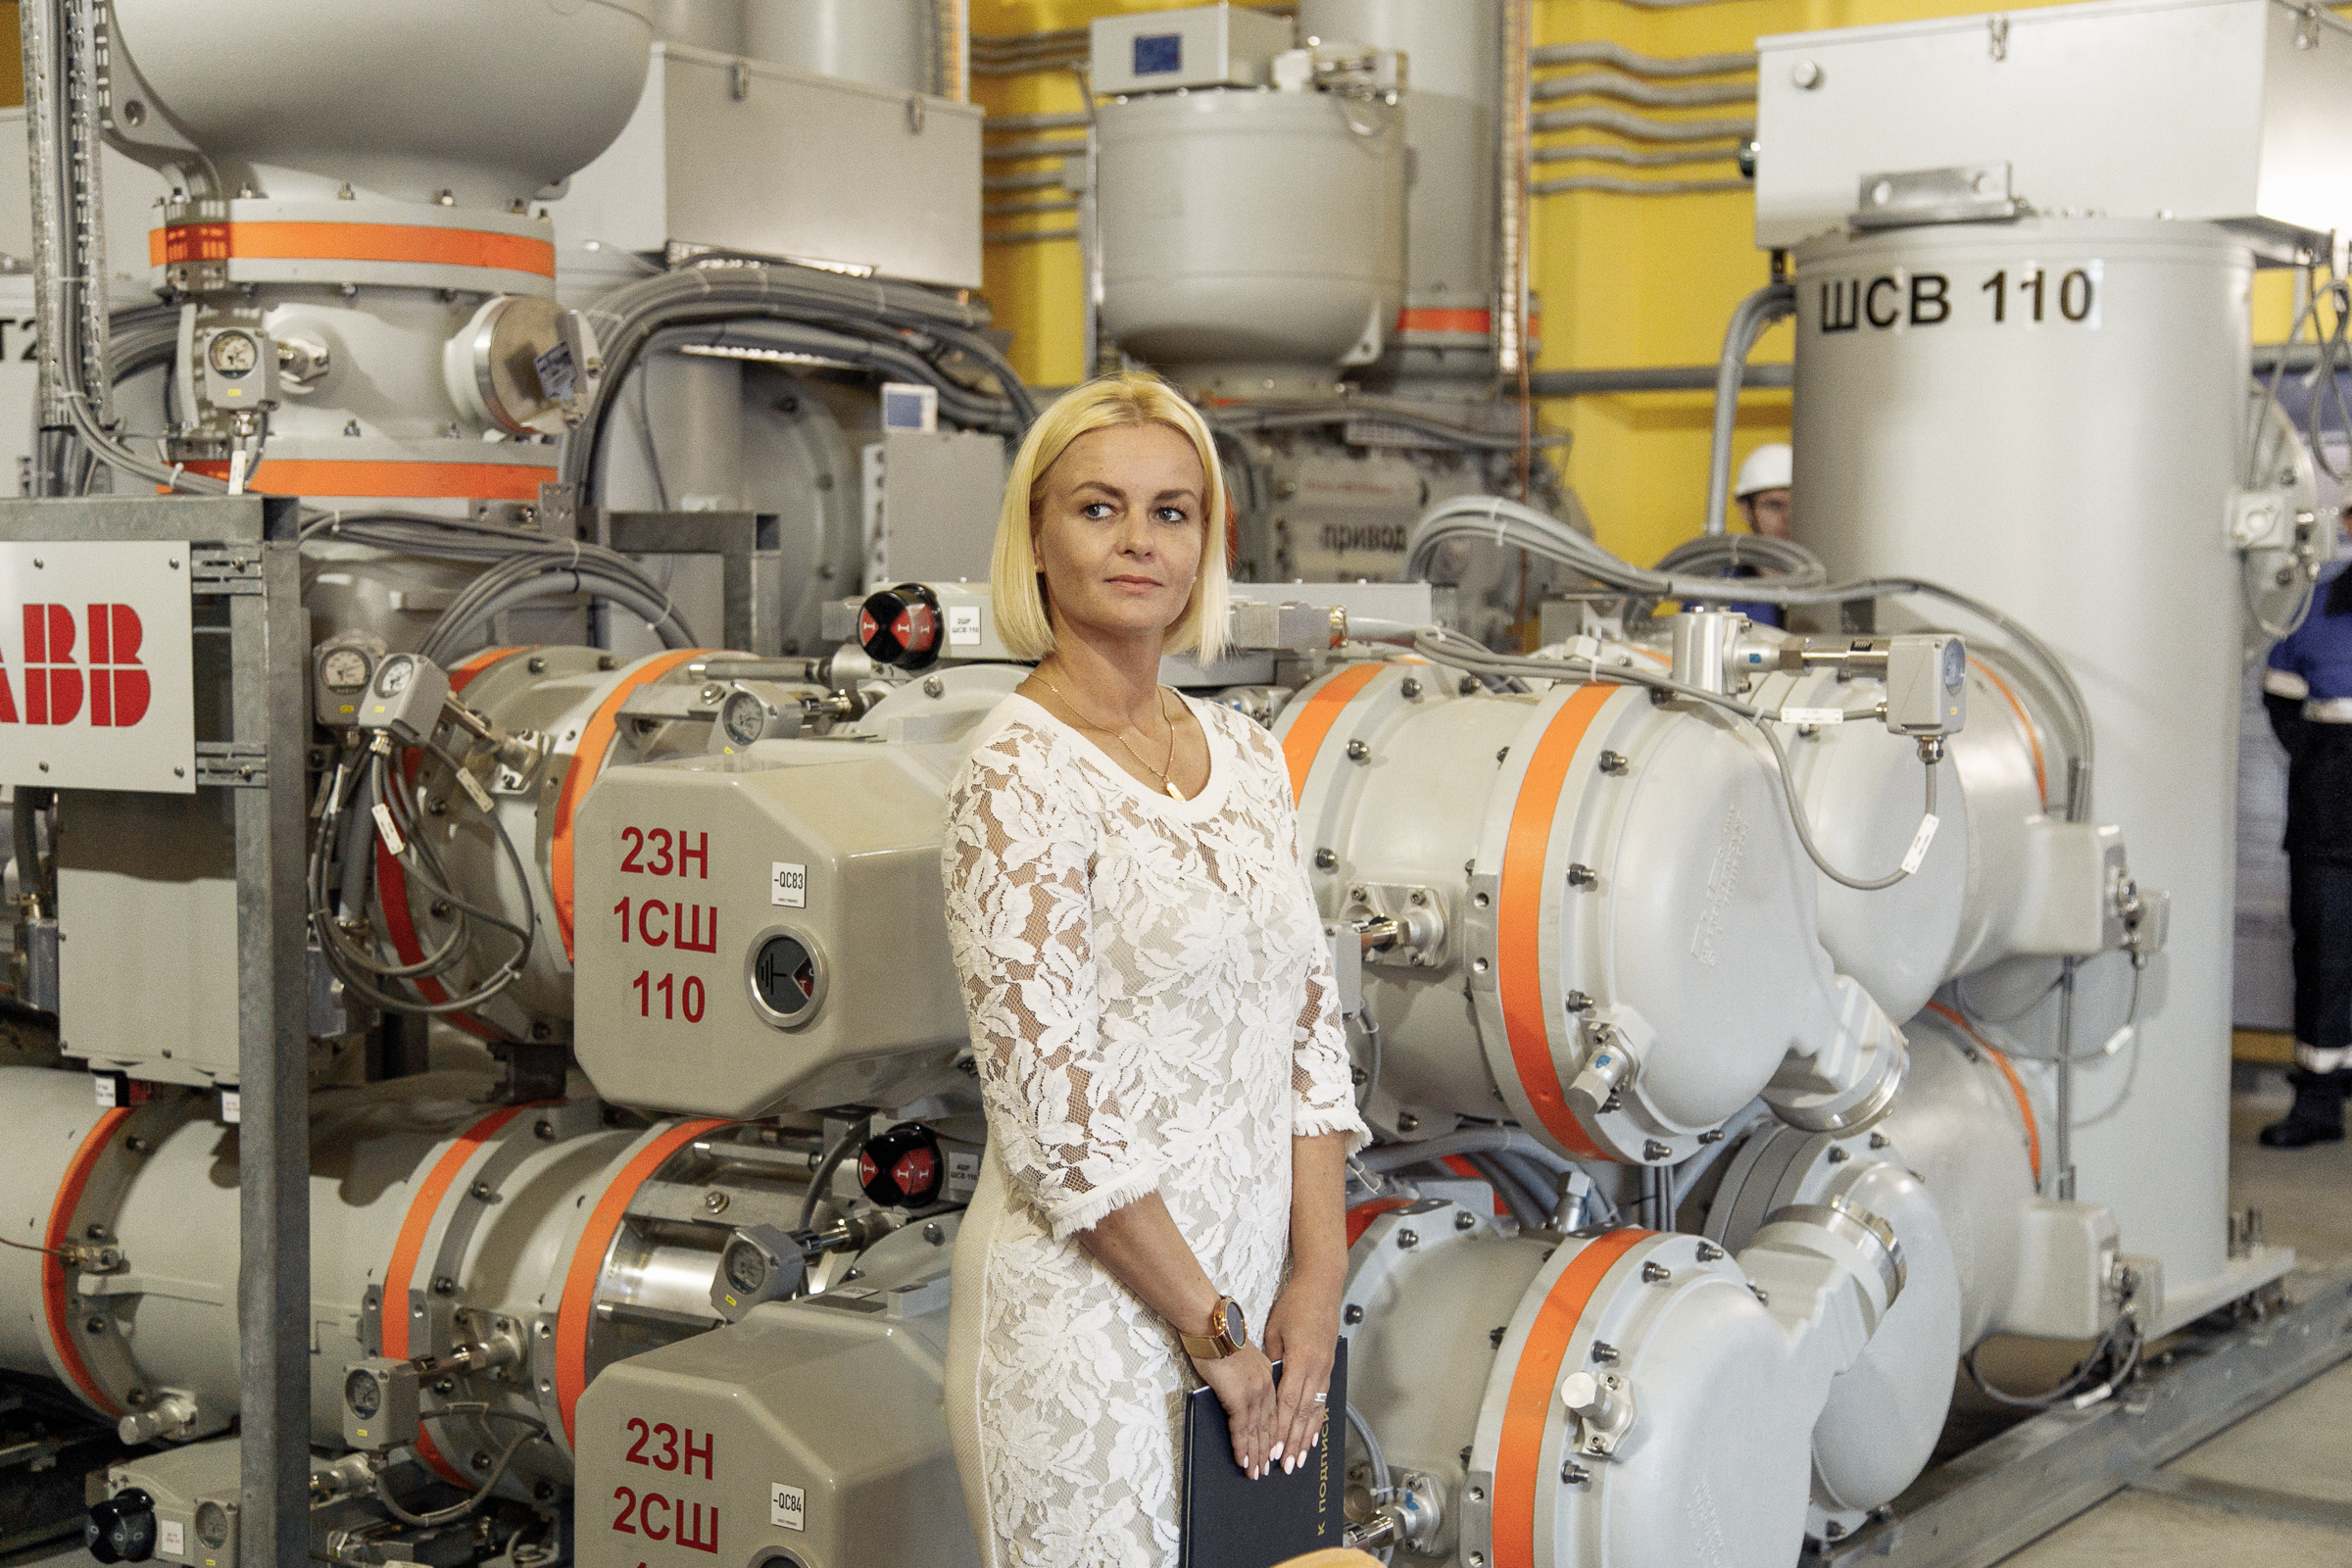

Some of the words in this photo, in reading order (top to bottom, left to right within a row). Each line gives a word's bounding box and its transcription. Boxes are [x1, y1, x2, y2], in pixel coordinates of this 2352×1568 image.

[1822, 272, 1952, 333] ШСВ
[1983, 270, 2094, 322] 110
[620, 826, 709, 880] 23Н
[773, 871, 804, 890] -QC83
[613, 896, 717, 955] 1СШ
[633, 969, 706, 1023] 110
[626, 1417, 713, 1481] 23Н
[612, 1486, 719, 1554] 2СШ
[773, 1492, 803, 1514] -QC84
